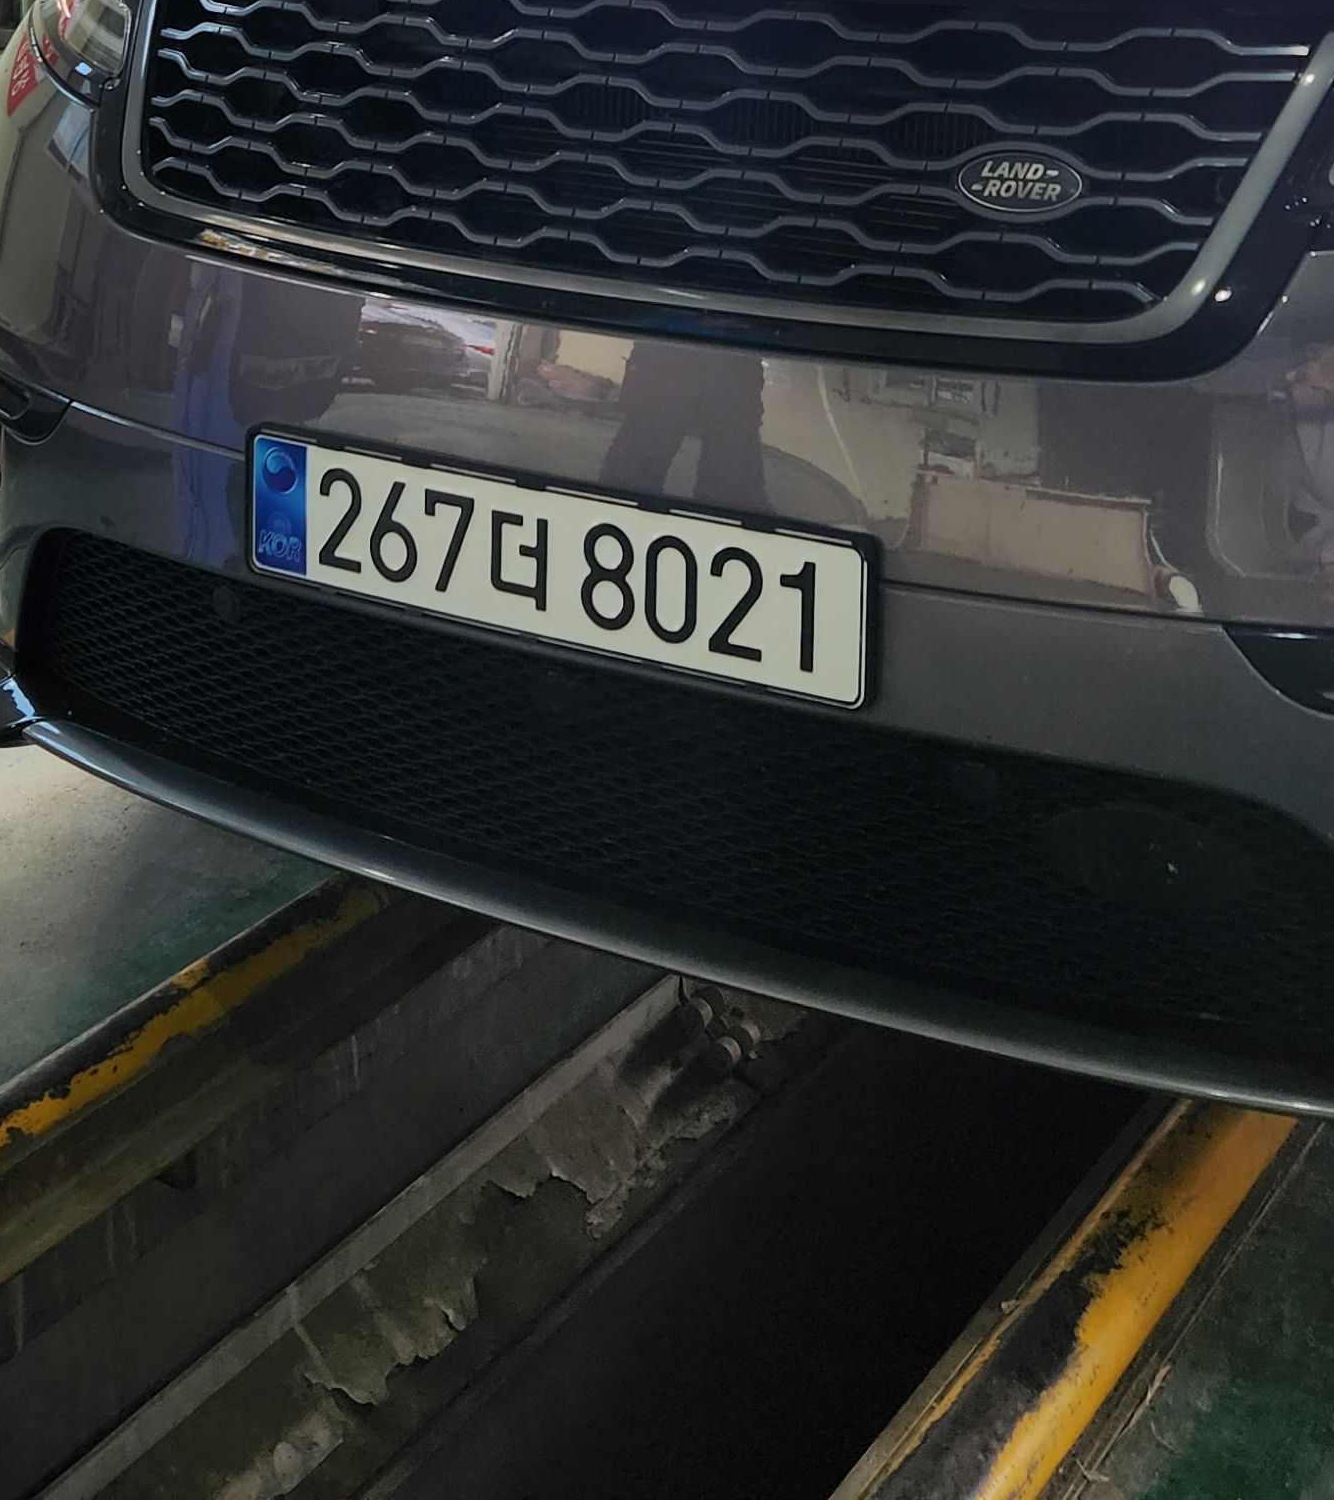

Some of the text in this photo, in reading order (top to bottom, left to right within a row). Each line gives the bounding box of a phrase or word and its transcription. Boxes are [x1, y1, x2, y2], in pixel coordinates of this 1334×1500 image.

[258, 530, 301, 562] KOR
[318, 468, 816, 672] 267더 8021
